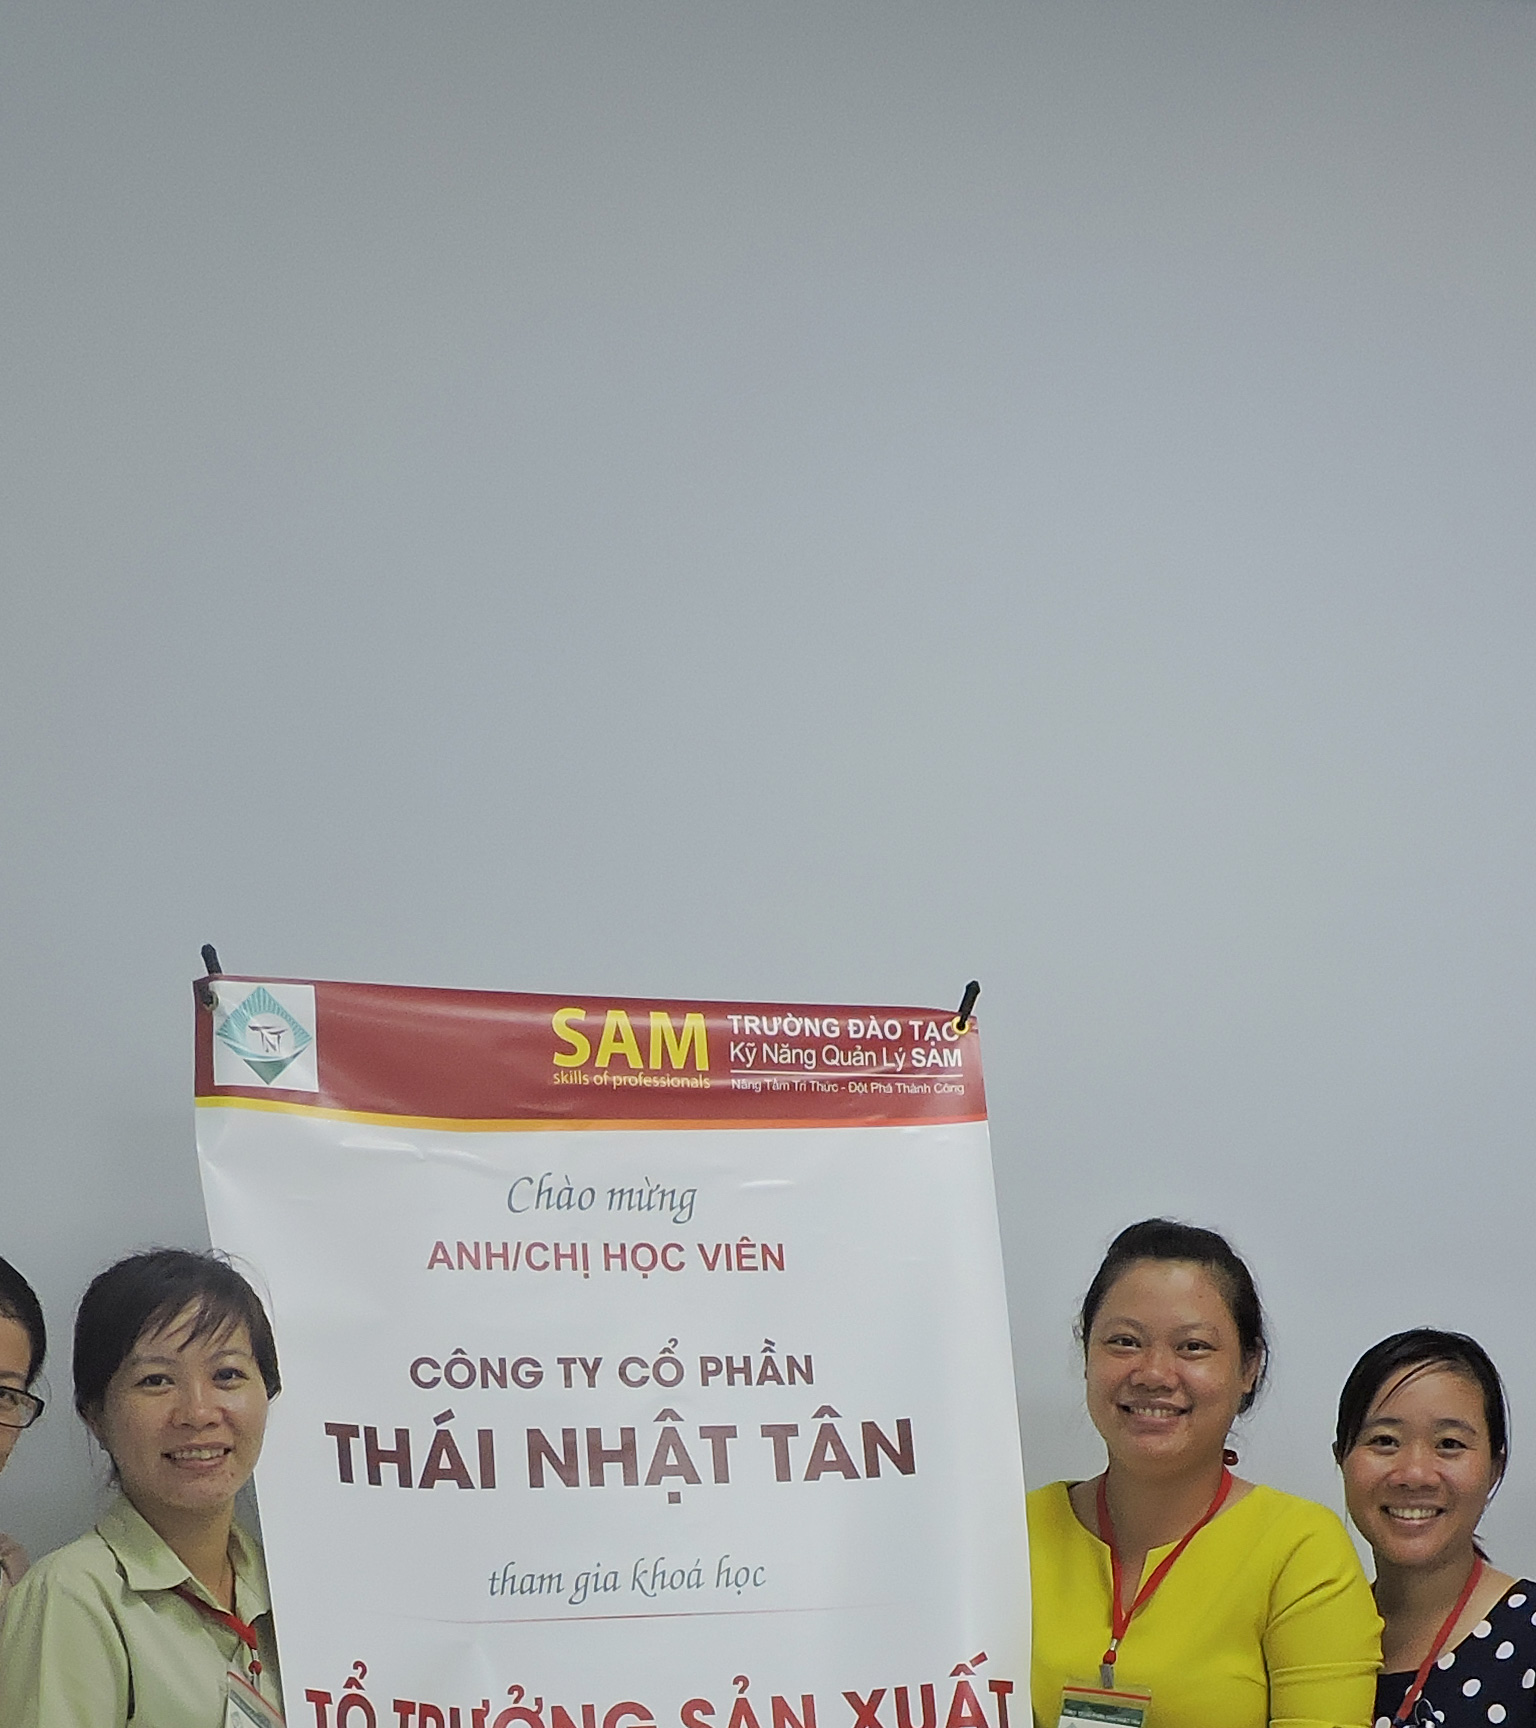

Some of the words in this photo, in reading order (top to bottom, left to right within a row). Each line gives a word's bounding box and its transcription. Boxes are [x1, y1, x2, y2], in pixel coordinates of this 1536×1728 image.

[551, 1007, 710, 1071] SAM
[727, 1012, 841, 1039] TRƯỜNG
[847, 1016, 902, 1041] ĐÀO
[553, 1070, 589, 1086] skills
[592, 1071, 610, 1087] of
[612, 1072, 711, 1090] professionals
[729, 1041, 757, 1068] Kỹ
[762, 1043, 817, 1069] Năng
[821, 1044, 877, 1067] Quản
[882, 1050, 906, 1071] Lý
[911, 1047, 963, 1068] SAM
[506, 1171, 596, 1214] Chào
[606, 1175, 698, 1224] mừng
[426, 1240, 590, 1280] ANH/CHỊ
[602, 1241, 686, 1280] HỌC
[697, 1235, 786, 1272] VIÊN
[409, 1347, 544, 1390] CÔNG
[556, 1356, 603, 1389] TY
[618, 1337, 685, 1388] CỔ
[699, 1338, 815, 1387] PHẦN
[324, 1408, 495, 1490] THÁI
[525, 1407, 739, 1505] NHẬT
[761, 1404, 918, 1483] TÂN
[488, 1561, 565, 1597] tham
[567, 1561, 622, 1606] gia
[630, 1556, 705, 1598] khoá
[715, 1554, 767, 1596] học
